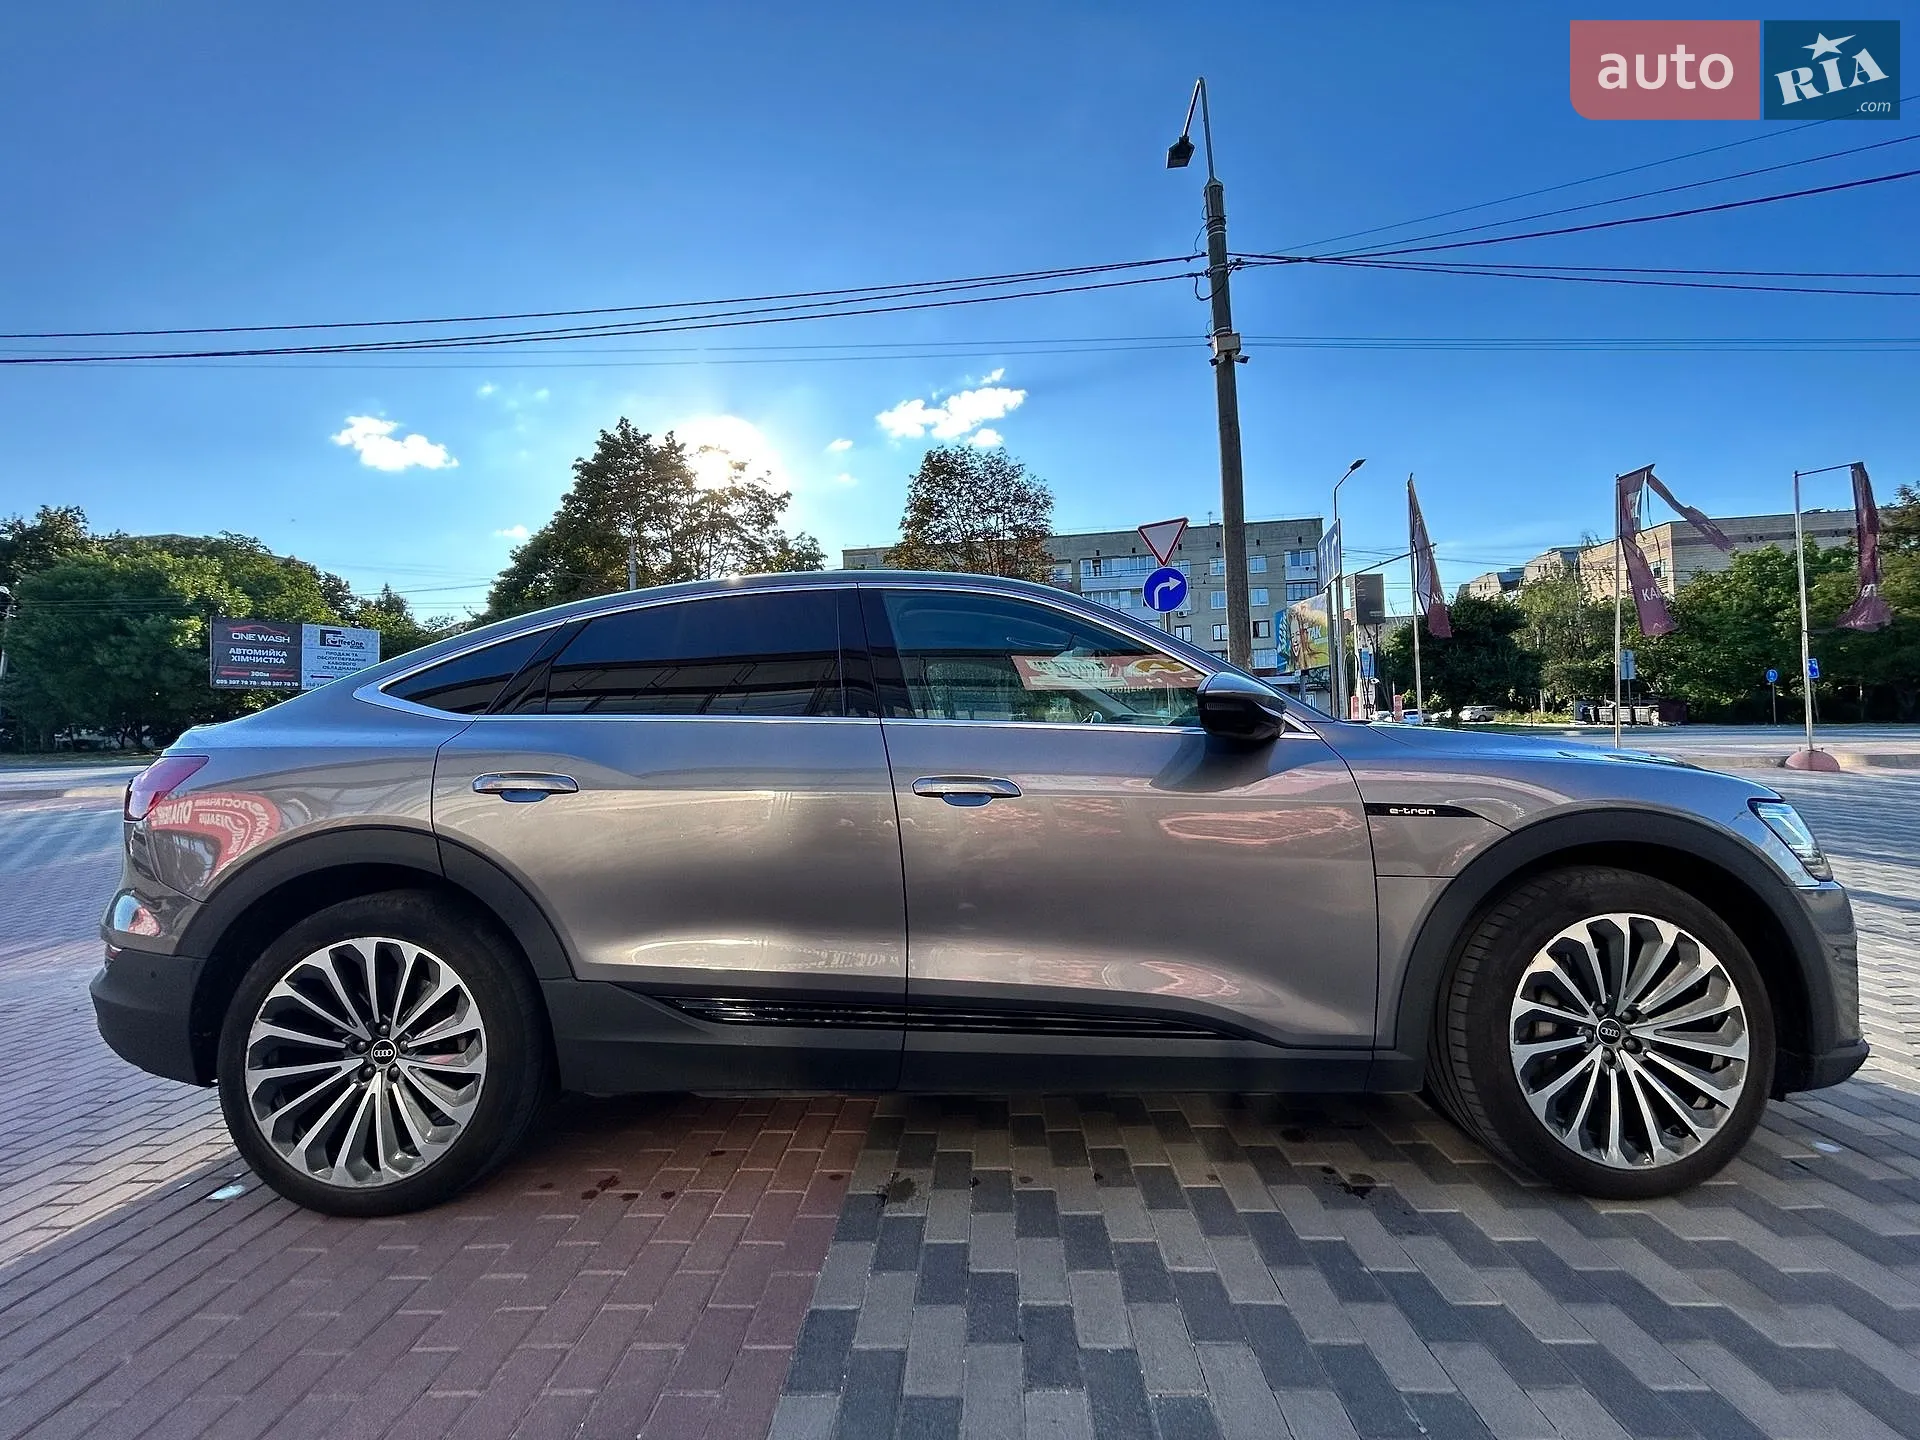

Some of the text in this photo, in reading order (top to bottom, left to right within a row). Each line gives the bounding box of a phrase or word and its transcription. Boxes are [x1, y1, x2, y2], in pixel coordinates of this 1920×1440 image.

[232, 632, 290, 643] ONE WASH
[229, 647, 288, 657] АВТОМИЙКА
[231, 655, 286, 664] ХІМЧИСТКА
[1389, 807, 1436, 815] e-tron
